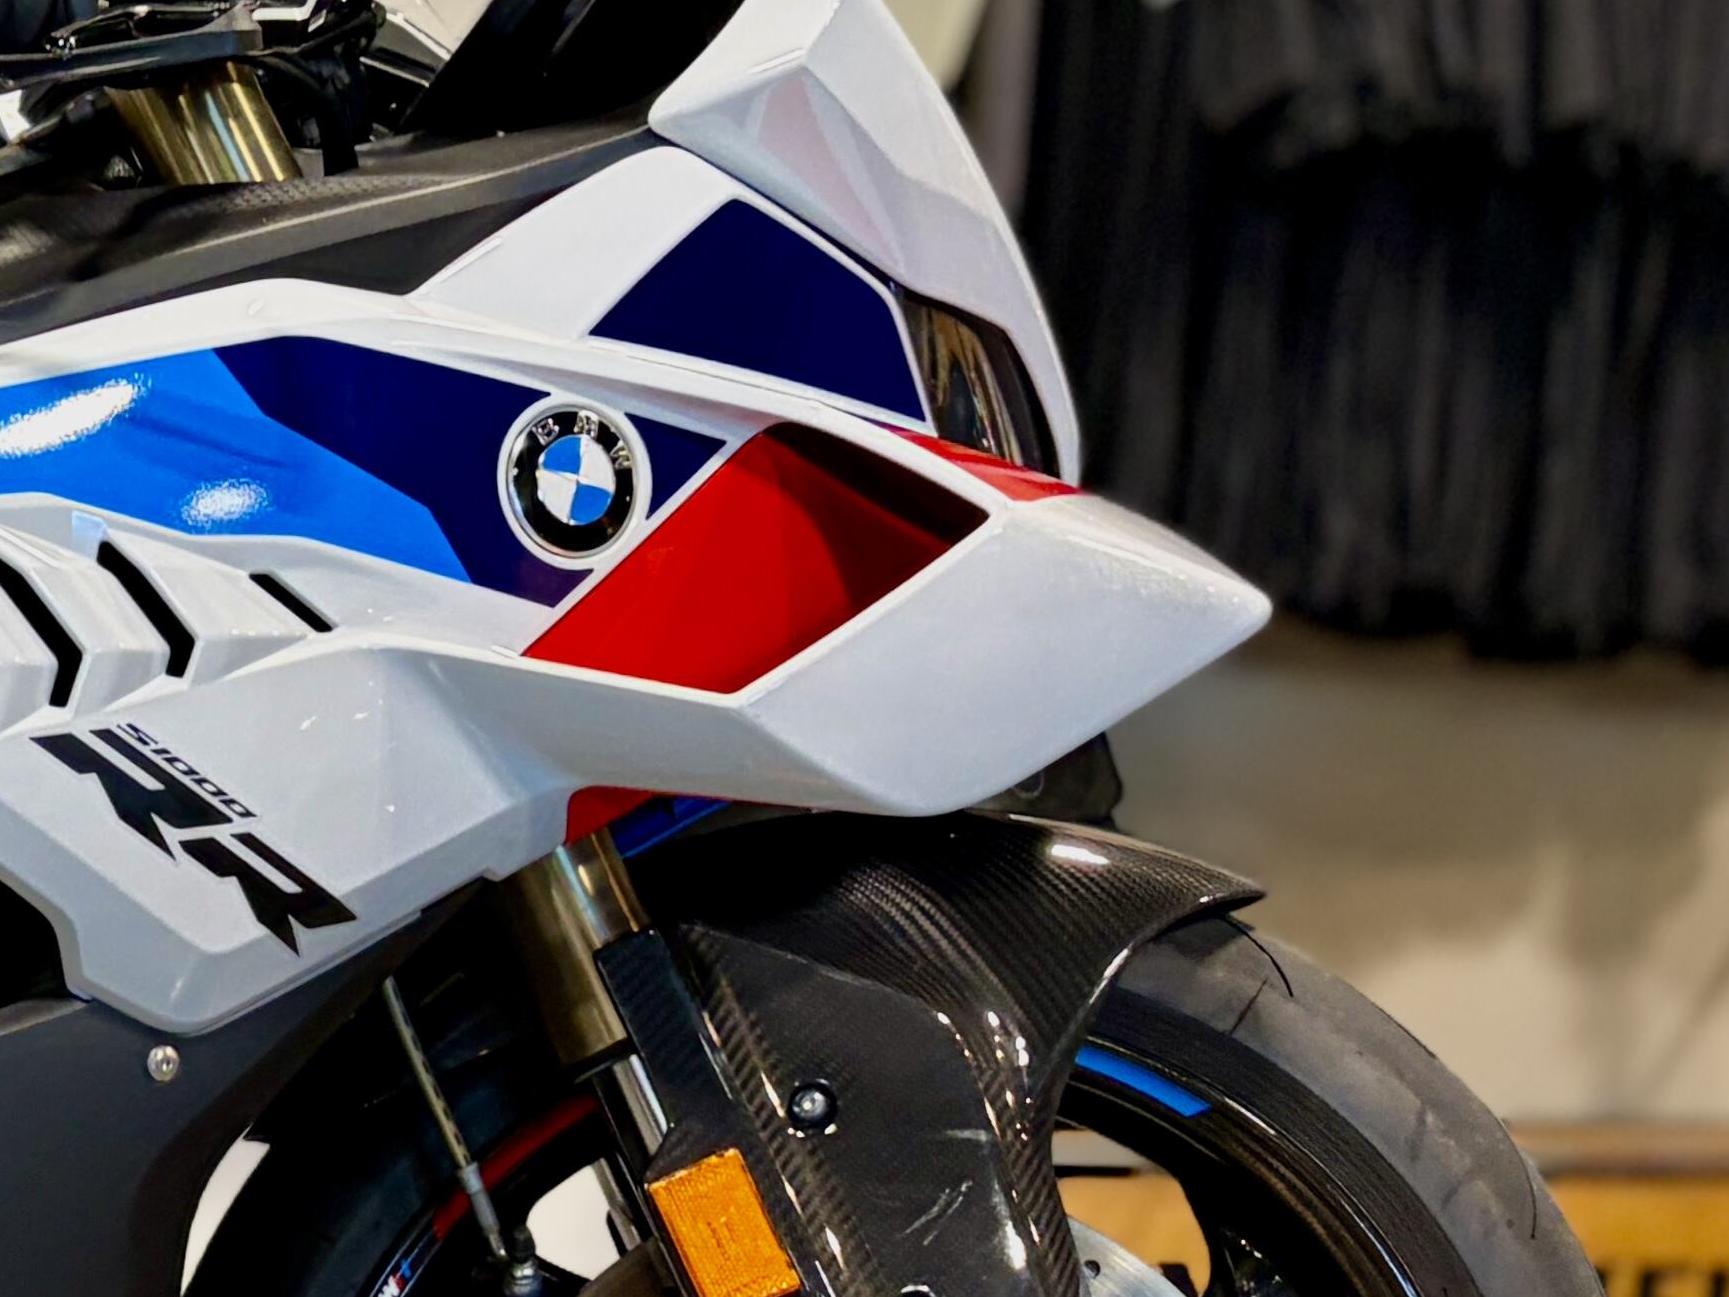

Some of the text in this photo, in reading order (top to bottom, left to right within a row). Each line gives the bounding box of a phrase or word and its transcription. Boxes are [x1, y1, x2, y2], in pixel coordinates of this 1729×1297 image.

[530, 409, 633, 471] BMW
[115, 721, 258, 820] S1000
[29, 728, 358, 959] RR
